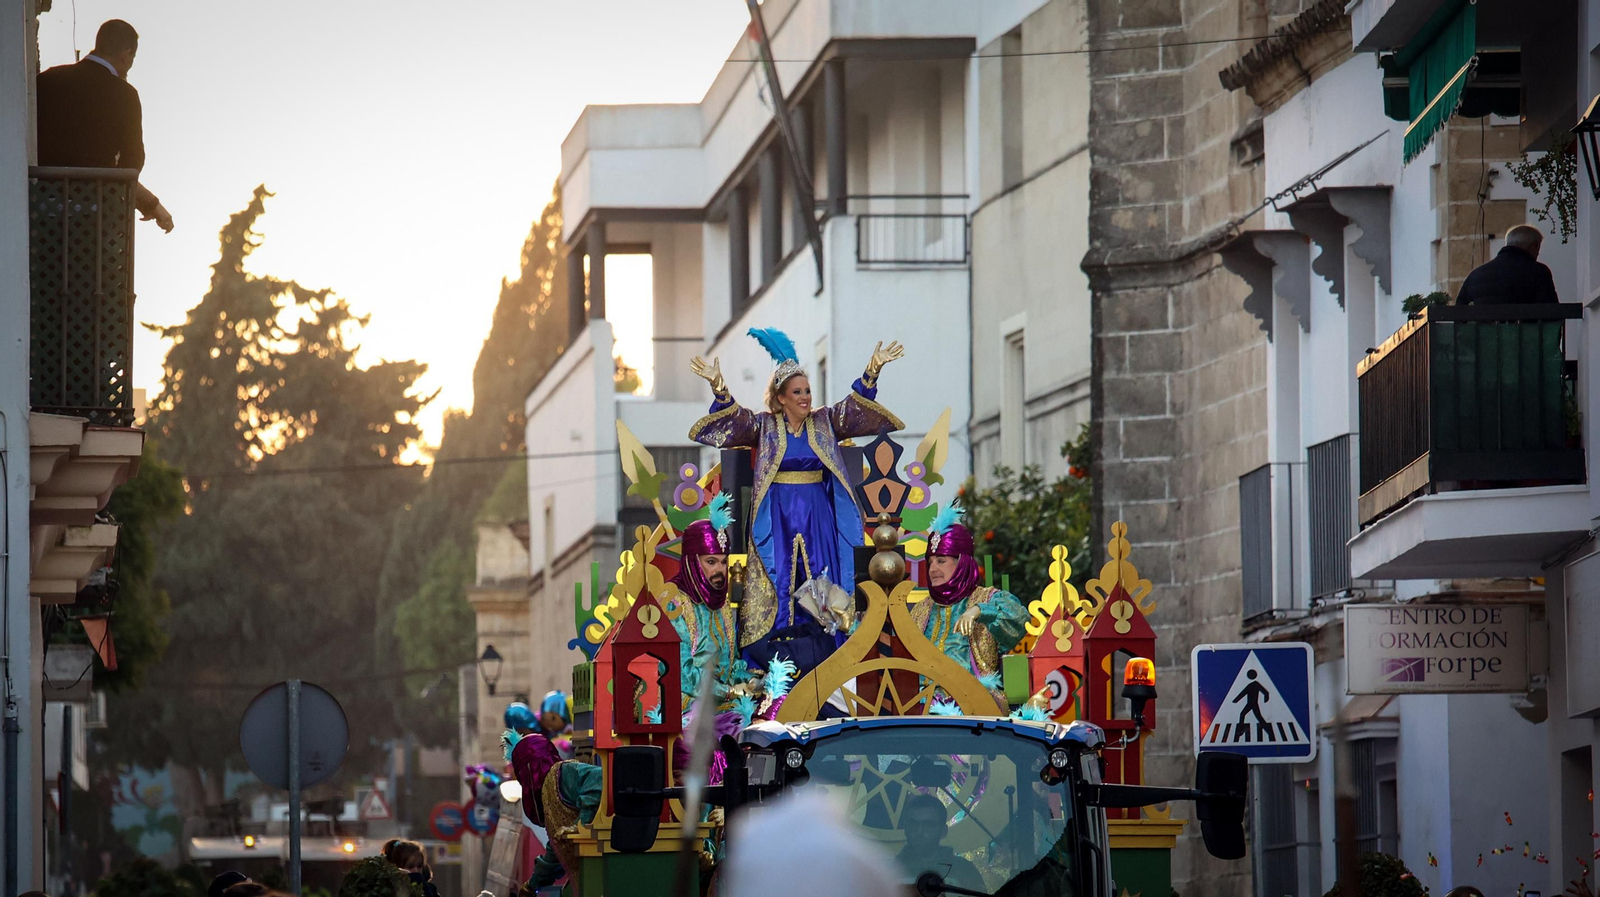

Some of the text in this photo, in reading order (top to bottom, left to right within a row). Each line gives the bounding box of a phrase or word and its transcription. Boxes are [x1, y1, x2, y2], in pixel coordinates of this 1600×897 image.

[1472, 608, 1502, 624] DE
[1369, 628, 1508, 649] ORMACIÓN
[1426, 656, 1502, 681] Forpe
